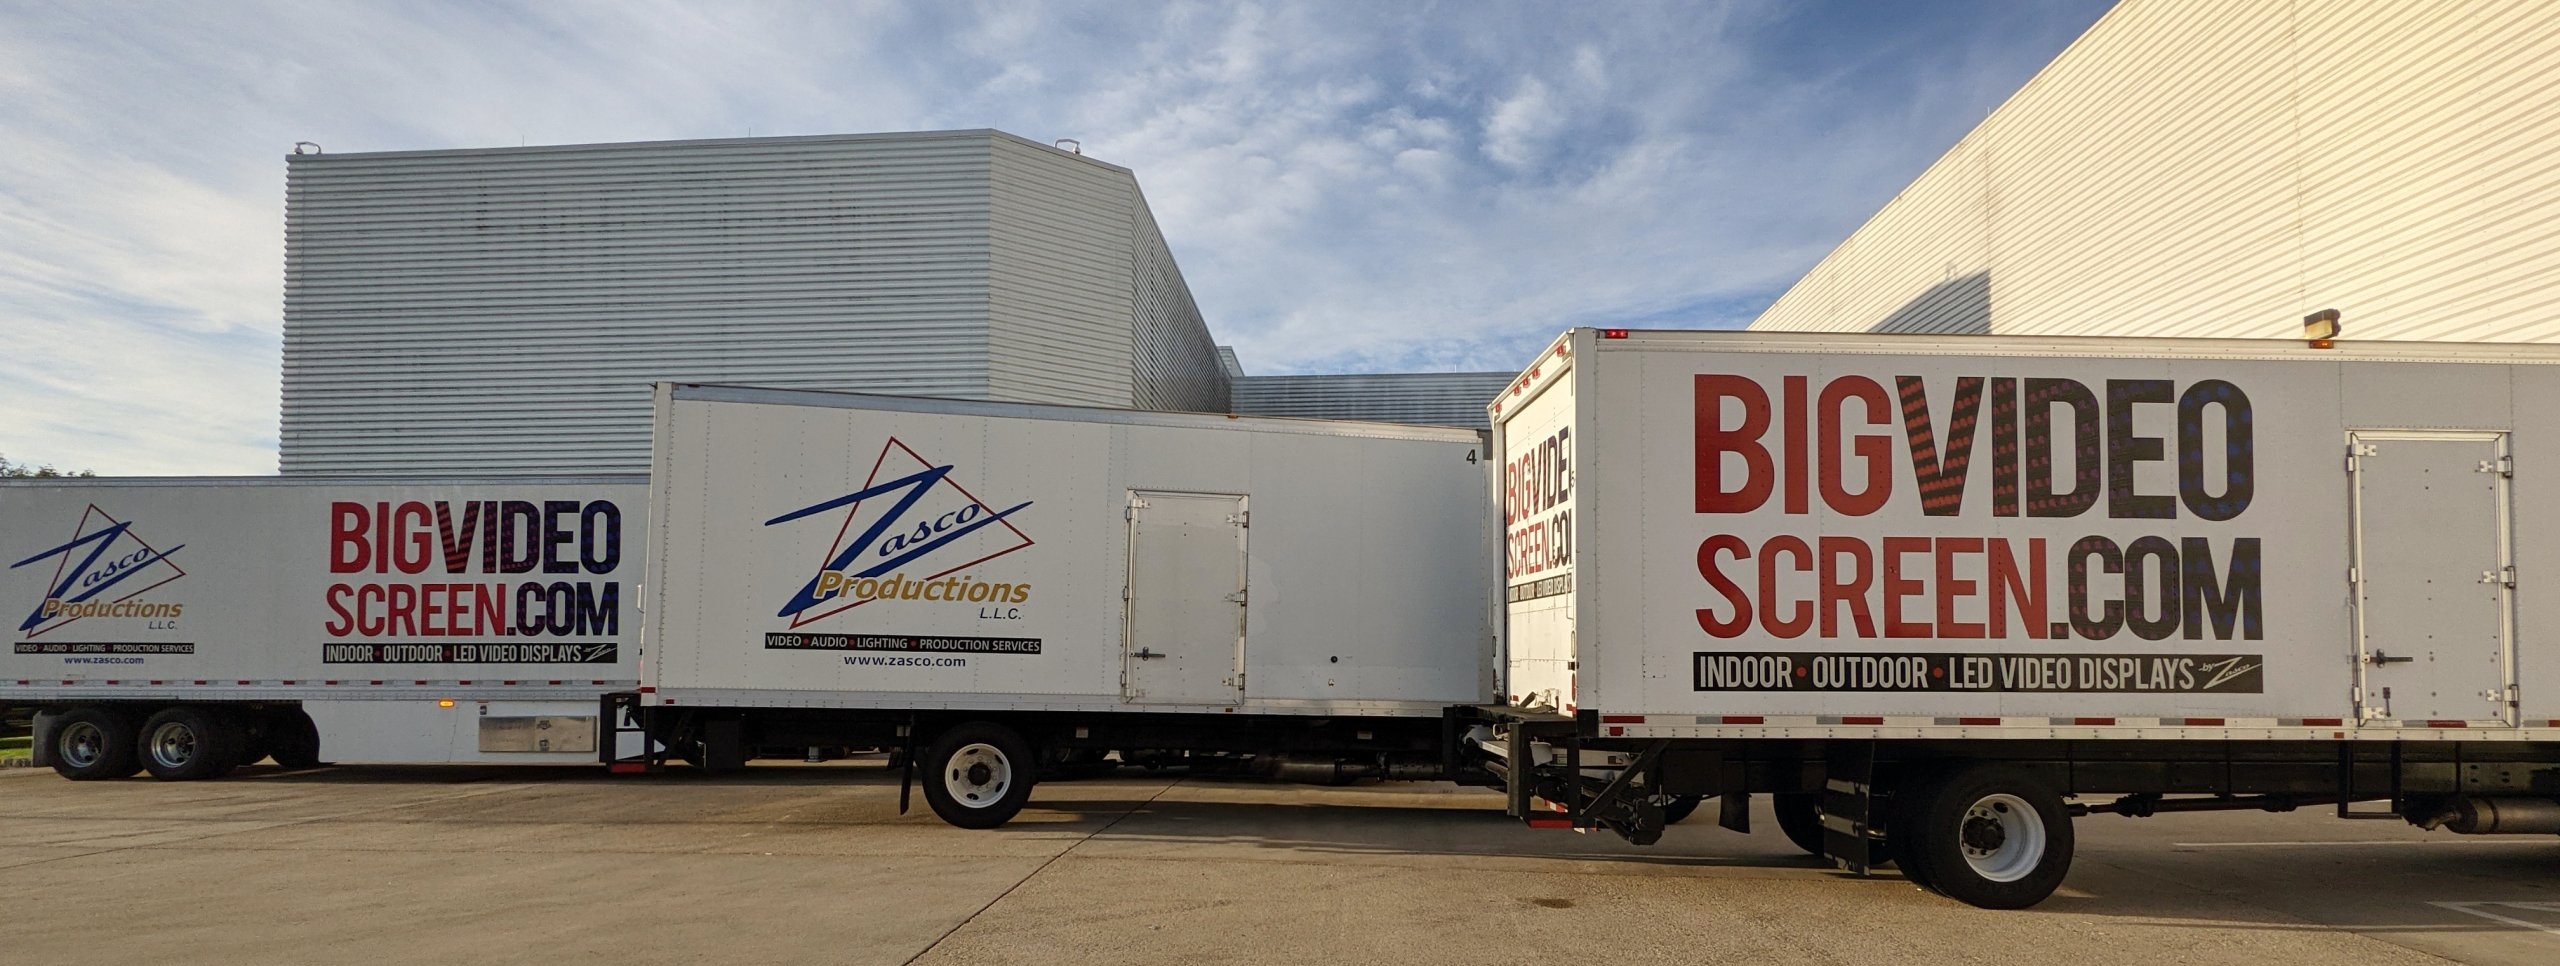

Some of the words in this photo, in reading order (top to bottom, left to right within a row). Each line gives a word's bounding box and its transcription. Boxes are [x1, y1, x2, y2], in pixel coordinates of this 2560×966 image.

[1466, 449, 1477, 464] 4
[1694, 374, 2255, 522] BIGVIDEO
[330, 500, 621, 575] BIGVIDEO
[764, 465, 1034, 617] Zasco
[10, 521, 186, 631] Zasco
[814, 571, 1032, 603] Productions
[1695, 534, 2264, 641] SCREEN.COM
[42, 599, 184, 618] Productions
[325, 581, 619, 637] SCREEN.COM
[979, 607, 1022, 620] L.L.C.
[16, 644, 38, 652] VIDEO
[43, 644, 67, 652] AUDIO
[73, 644, 106, 652] LIGHTING
[161, 645, 193, 653] SERVICES
[326, 645, 374, 662] INDOOR
[383, 645, 443, 662] OUTDOOR
[453, 645, 476, 662] LED
[479, 645, 518, 662] VIDEO
[520, 645, 582, 662] DISPLAYS
[767, 635, 801, 647] VIDEO
[810, 635, 848, 648] AUDIO
[857, 637, 908, 649] LIGHTING
[919, 638, 990, 651] PRODUCTION
[992, 640, 1040, 652] SERVICES
[64, 656, 145, 664] www.zasco.com
[843, 655, 966, 667] www.zasco.com
[1700, 656, 1793, 688] INDOOR
[1812, 656, 1928, 689] OUTDOOR
[1949, 657, 1993, 689] LED
[2000, 657, 2072, 689] VIDEO
[2079, 657, 2195, 690] DISPLAYS
